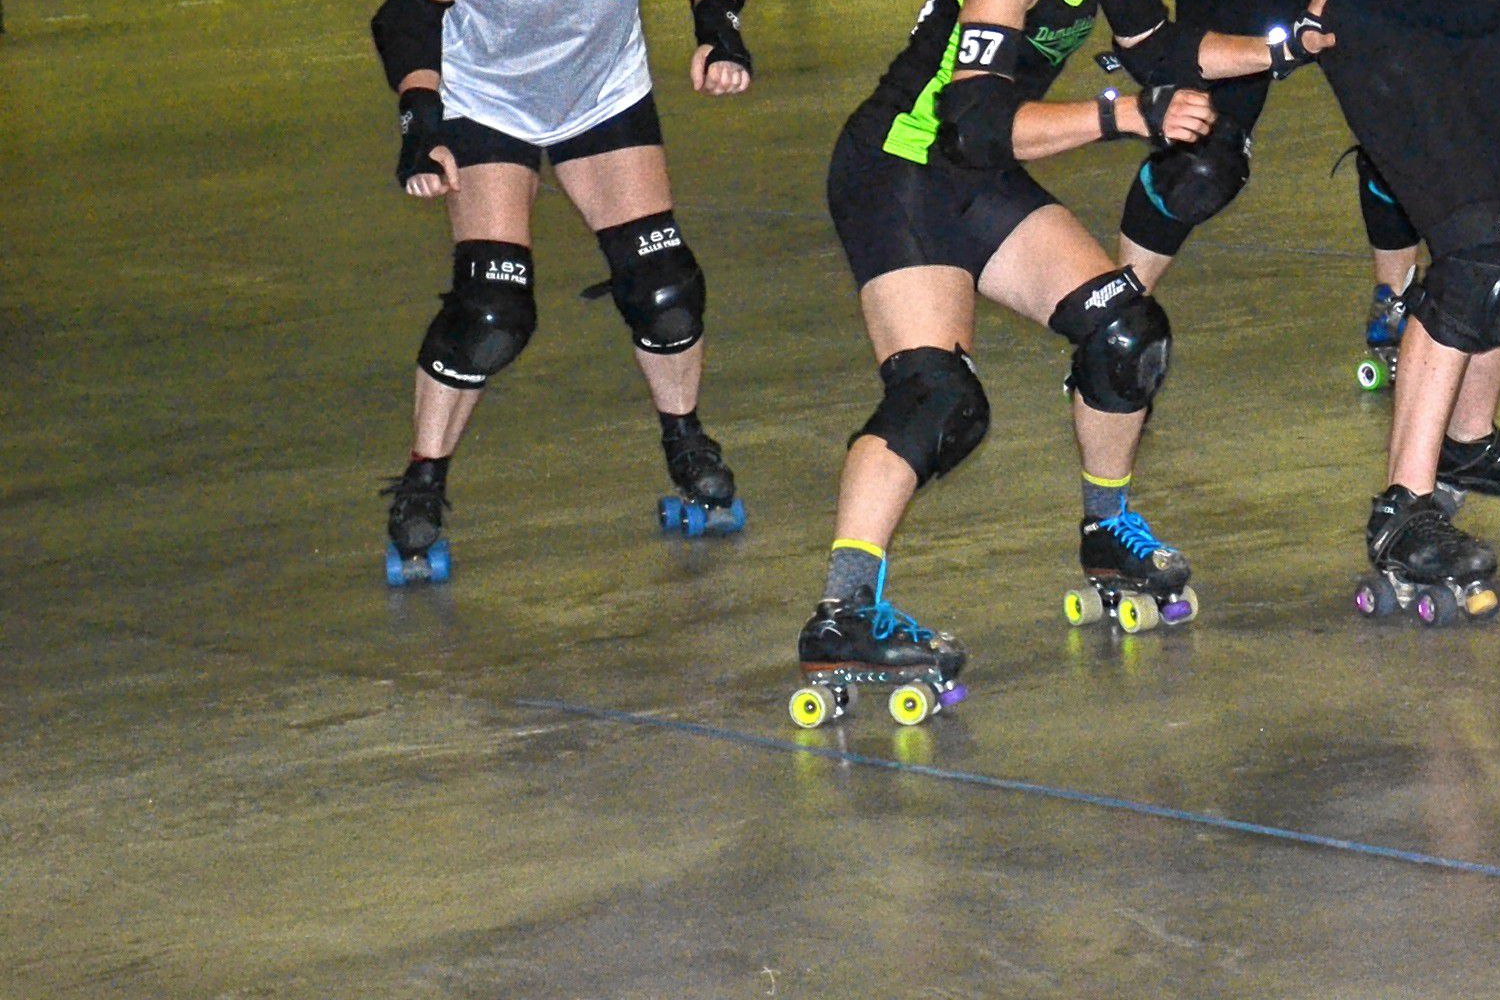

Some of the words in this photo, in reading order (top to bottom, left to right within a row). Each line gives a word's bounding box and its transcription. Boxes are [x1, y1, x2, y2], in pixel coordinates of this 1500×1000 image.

[958, 29, 1004, 65] 57
[638, 227, 676, 247] 187
[488, 260, 526, 275] 187
